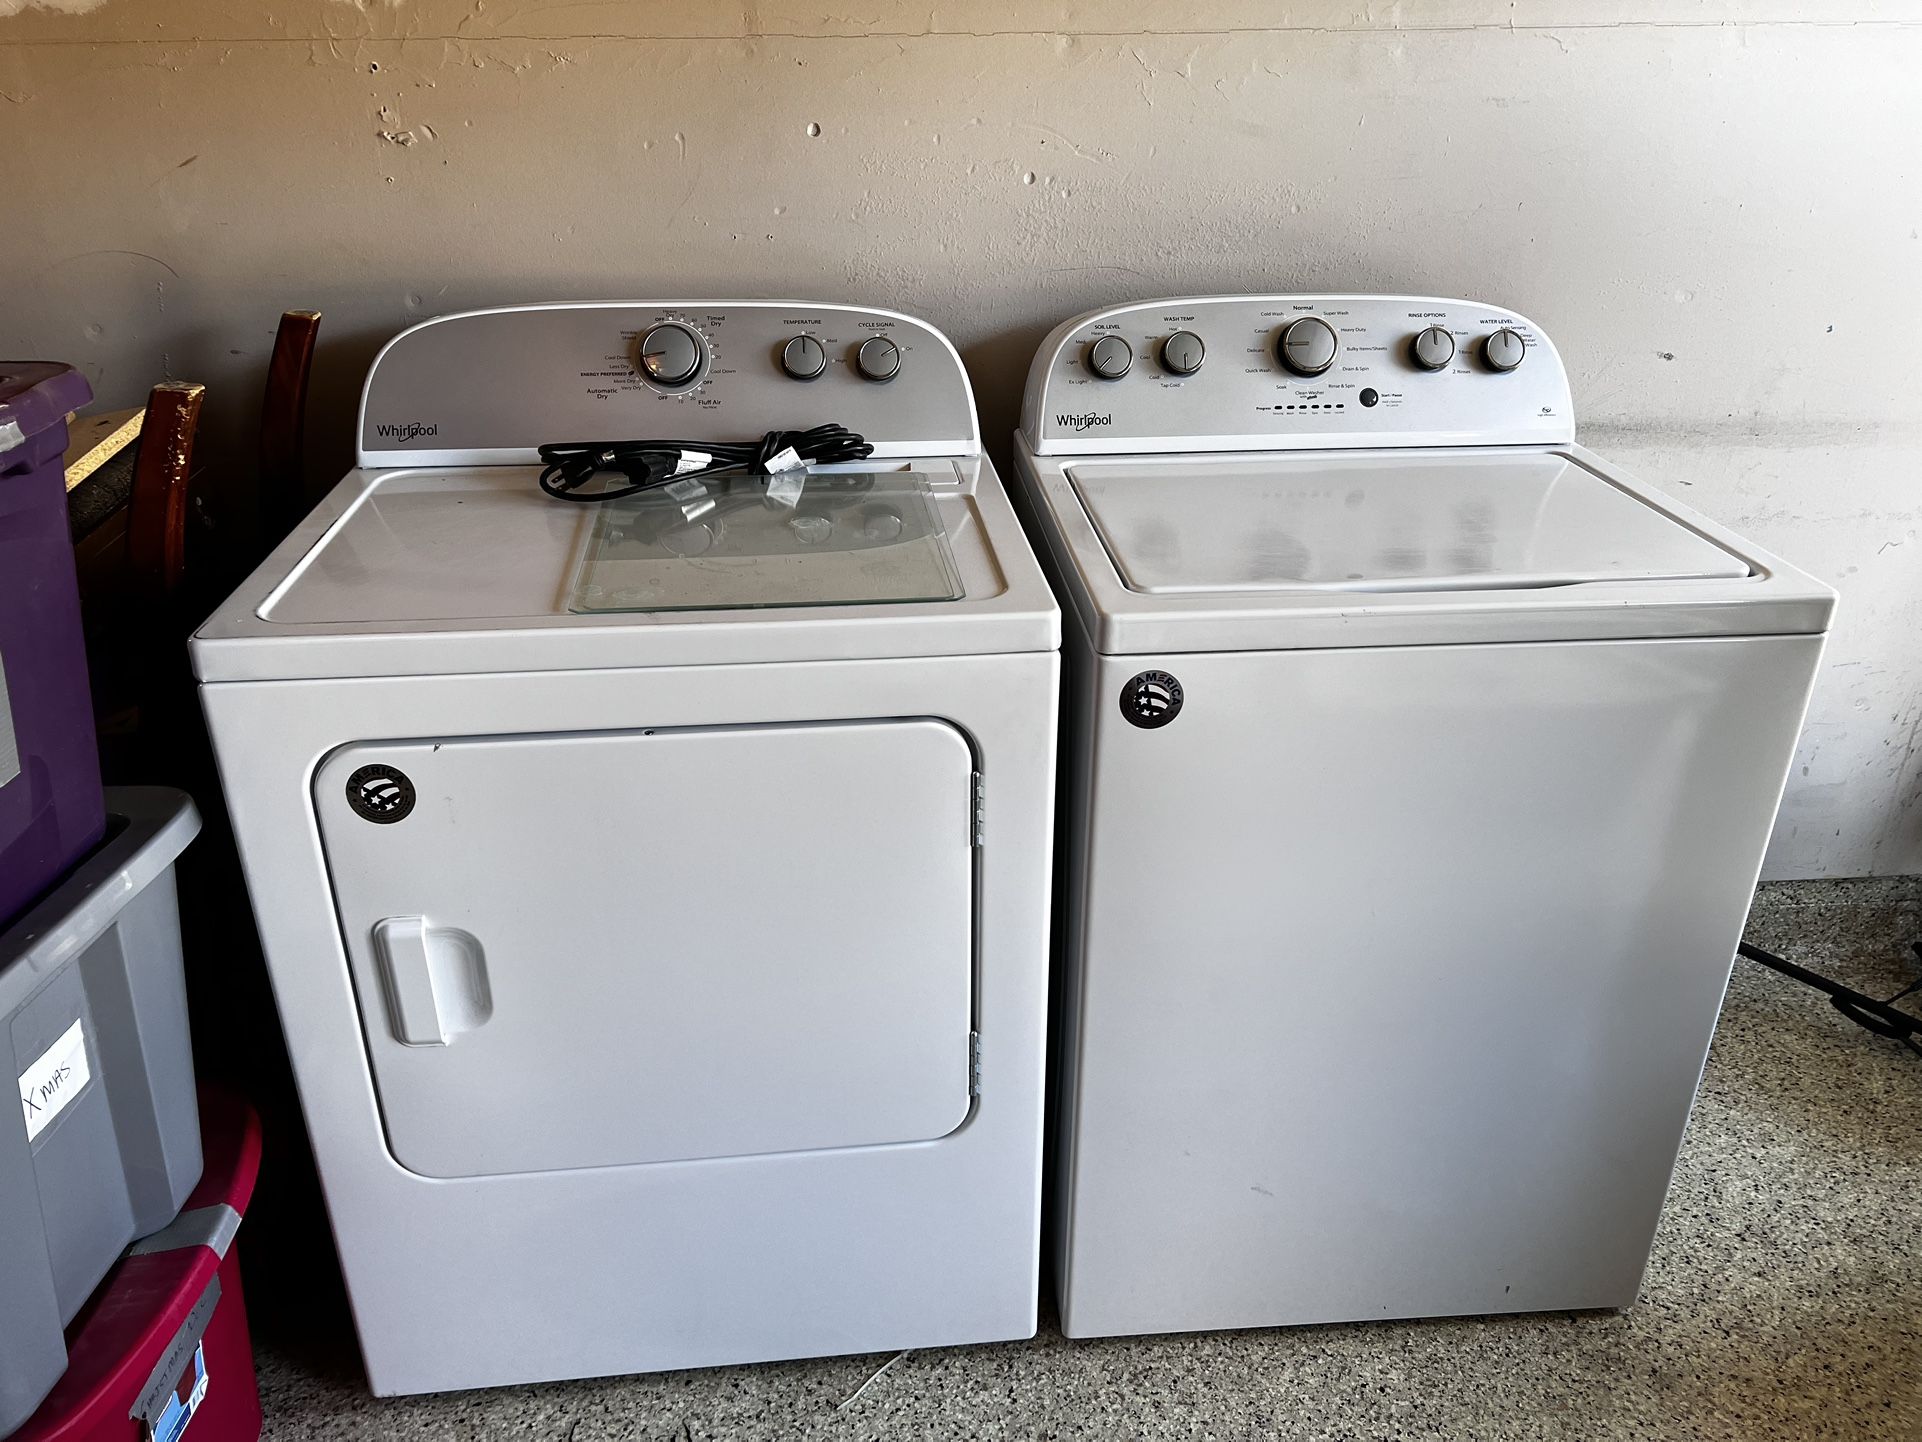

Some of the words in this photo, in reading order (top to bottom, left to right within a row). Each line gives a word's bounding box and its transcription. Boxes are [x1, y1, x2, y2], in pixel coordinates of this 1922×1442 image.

[1056, 412, 1112, 431] Whirlpool
[377, 422, 438, 442] Whirlpool
[1136, 672, 1181, 706] AMERICA
